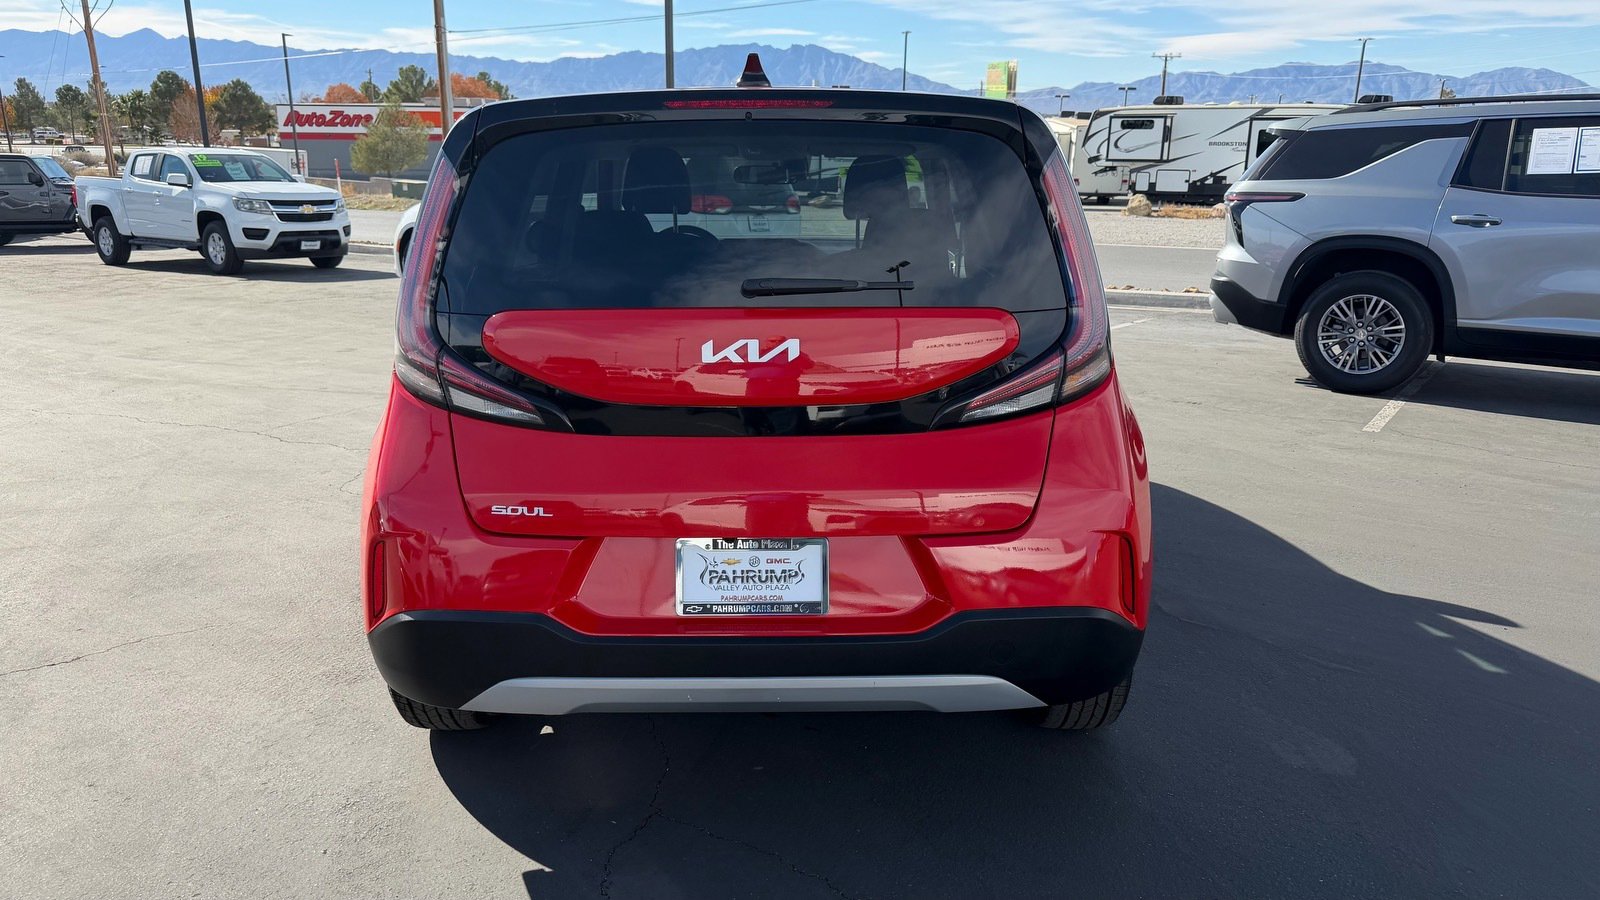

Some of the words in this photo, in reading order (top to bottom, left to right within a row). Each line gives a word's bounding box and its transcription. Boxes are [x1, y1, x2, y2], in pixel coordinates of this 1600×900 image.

[283, 110, 374, 128] AutoZone
[701, 338, 800, 363] KIA
[491, 505, 554, 517] SOUL
[716, 539, 734, 550] The
[737, 539, 759, 550] Auto
[708, 569, 799, 585] PAHRUMP
[713, 584, 740, 592] VALLEY
[720, 594, 784, 602] PAHRUMPCARS.COM
